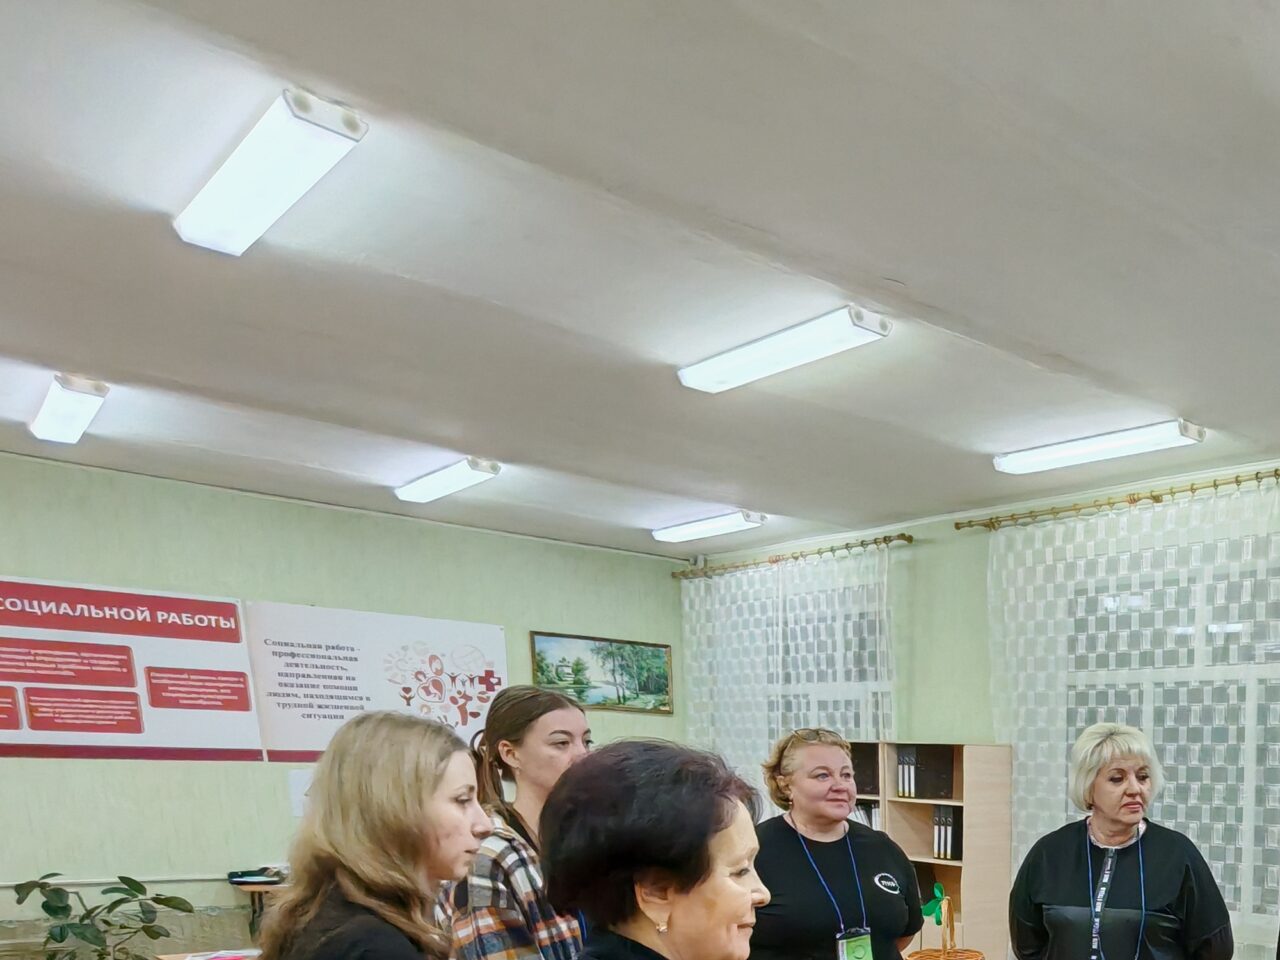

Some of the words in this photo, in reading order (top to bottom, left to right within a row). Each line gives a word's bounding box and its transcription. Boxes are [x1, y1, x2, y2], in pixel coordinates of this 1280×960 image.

[157, 611, 236, 630] РАБОТЫ
[263, 638, 323, 649] Социальная
[325, 644, 355, 652] работа
[271, 650, 359, 662] профессиональная
